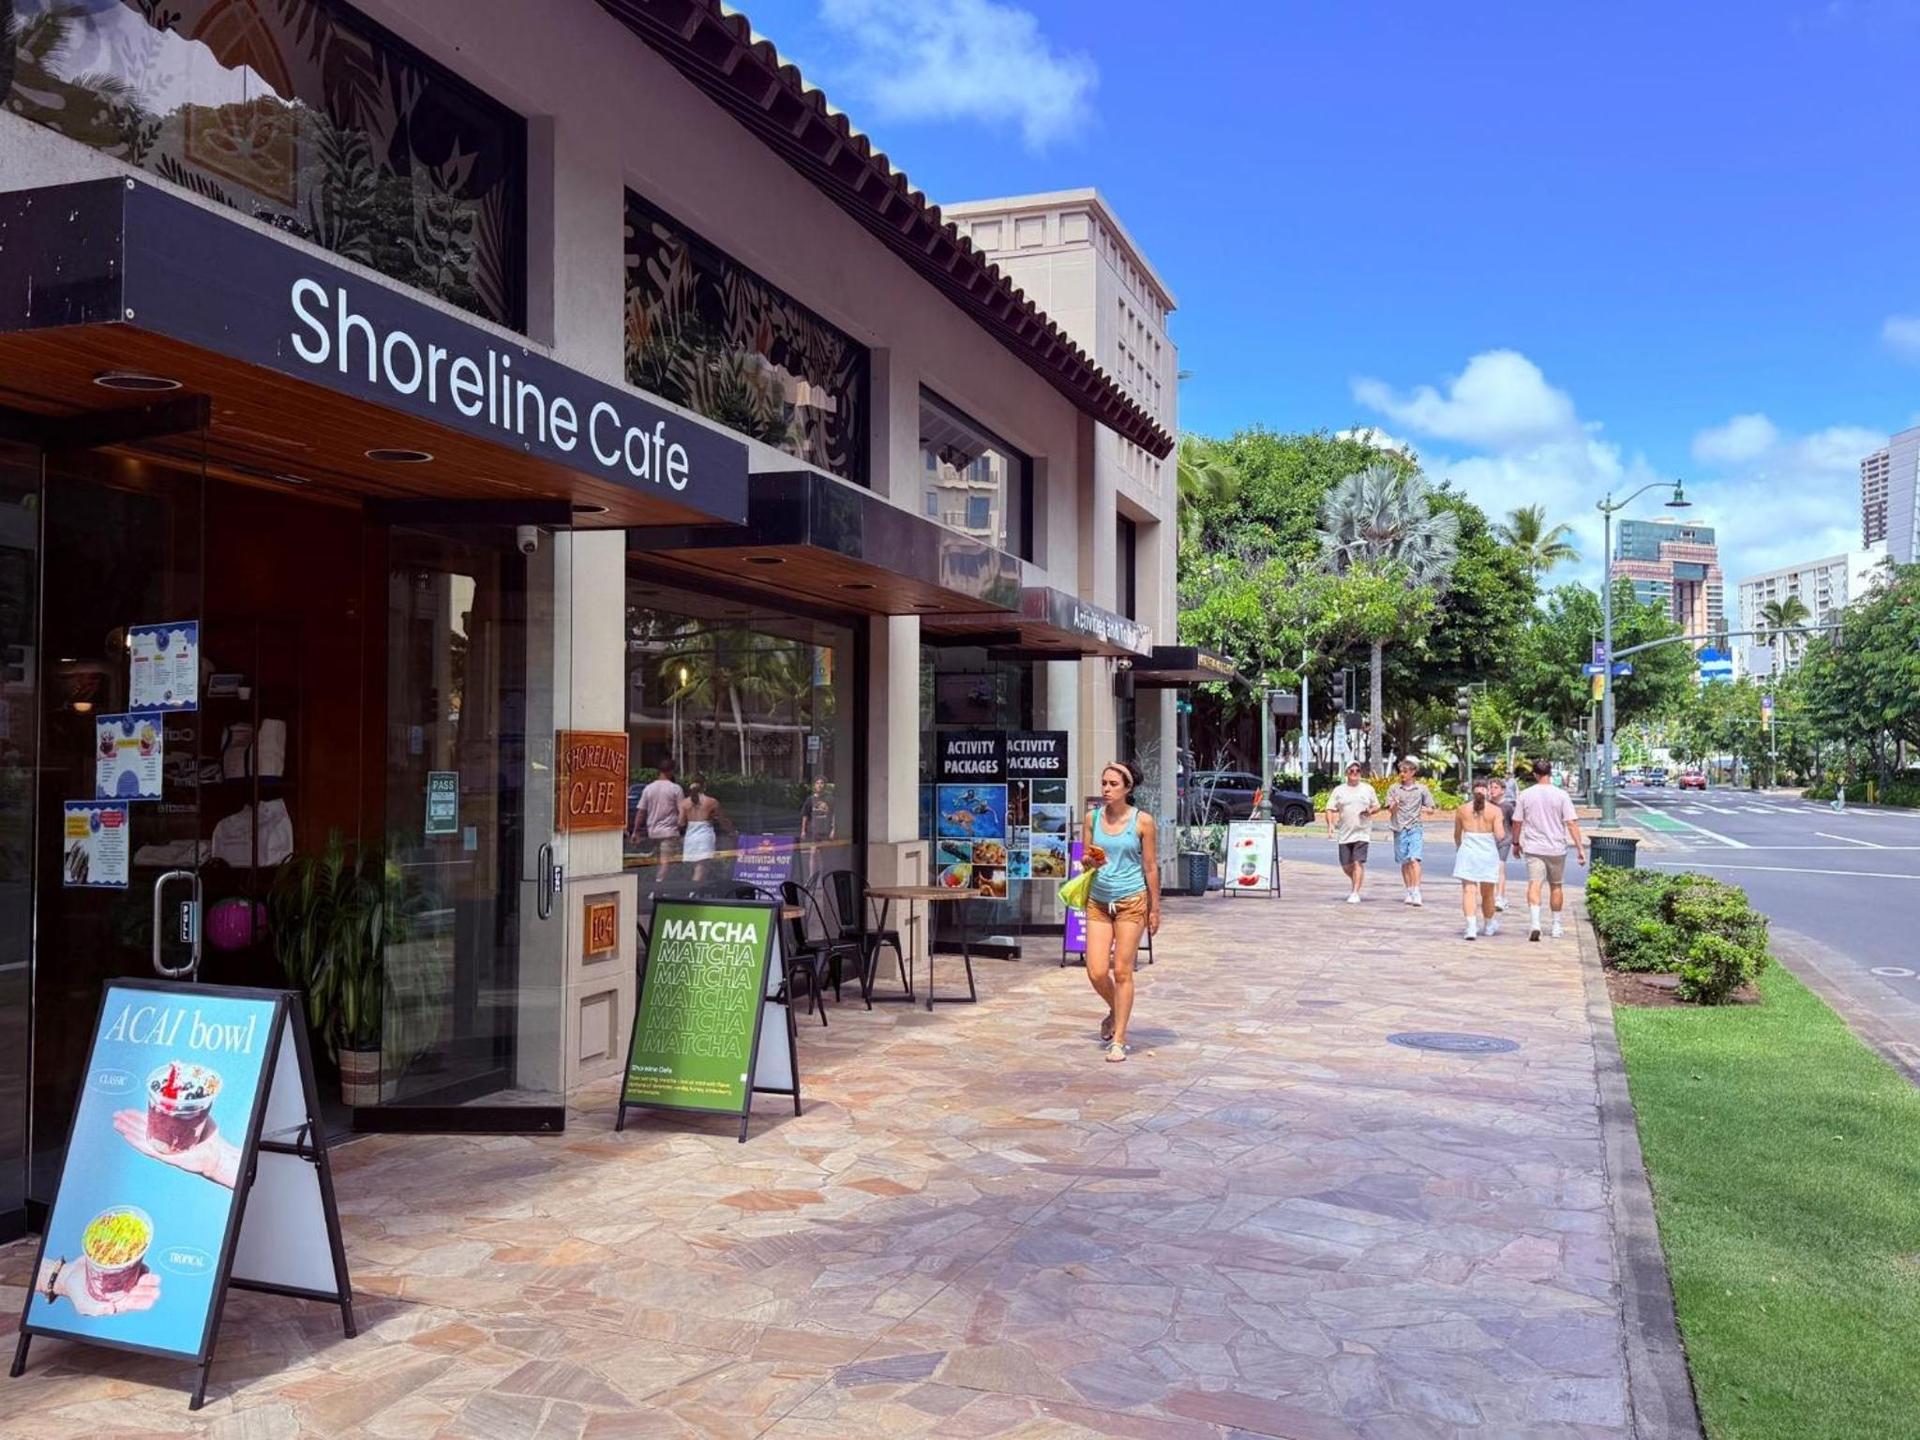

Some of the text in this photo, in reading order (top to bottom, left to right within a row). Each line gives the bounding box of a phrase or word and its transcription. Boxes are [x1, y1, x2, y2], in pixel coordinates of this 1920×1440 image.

[290, 277, 690, 491] Shoreline Cafe
[566, 745, 625, 775] SHORELINE
[947, 740, 995, 754] ACTIVITY
[1006, 740, 1056, 752] ACTIVITY
[944, 760, 999, 774] PACKAGES
[432, 780, 454, 790] PASS
[570, 781, 615, 815] CAFE
[593, 915, 613, 942] 104
[661, 919, 758, 944] MATCHA
[657, 941, 755, 968] MATCHA
[653, 962, 752, 990] MATCHA
[650, 984, 749, 1012] MATCHA
[104, 1003, 257, 1054] ACAI bowl
[646, 1006, 746, 1035] MATCHA
[641, 1029, 743, 1058] MATCHA
